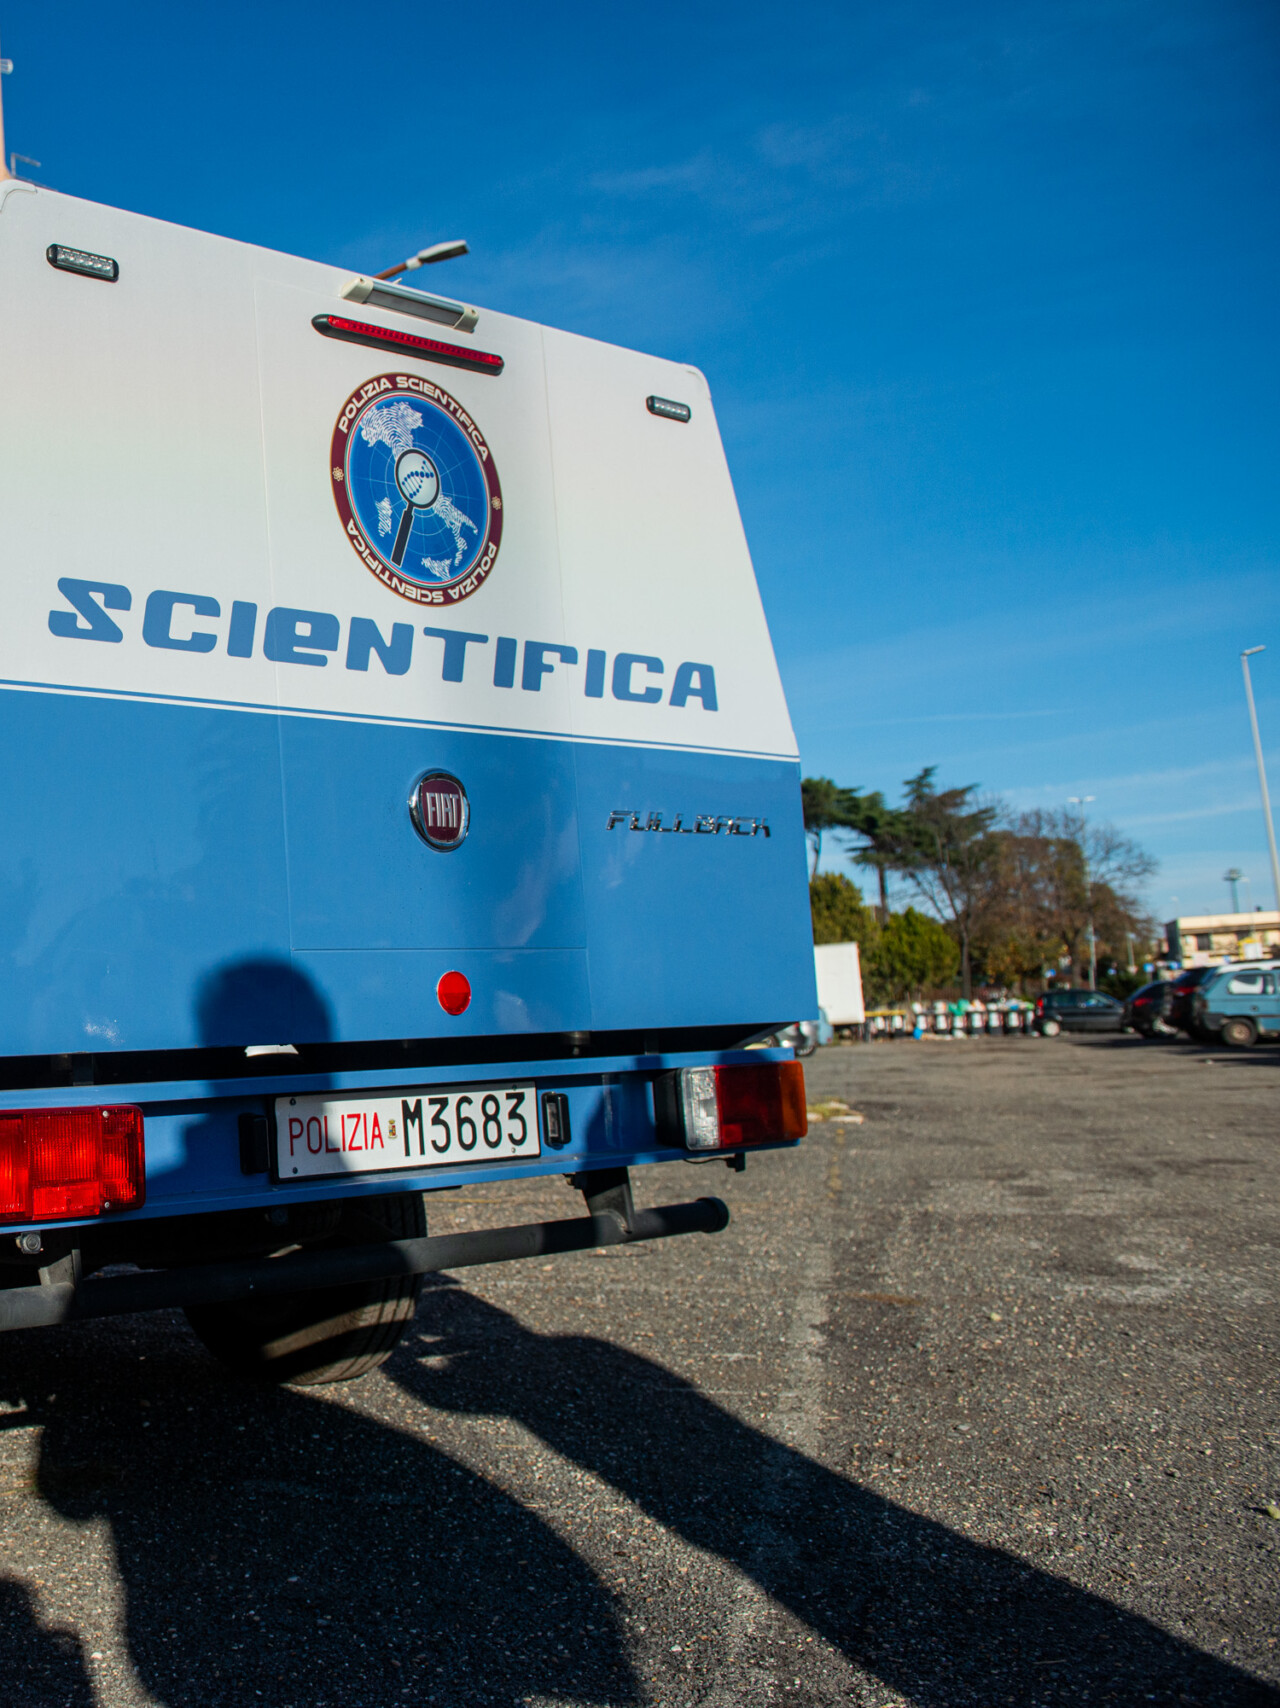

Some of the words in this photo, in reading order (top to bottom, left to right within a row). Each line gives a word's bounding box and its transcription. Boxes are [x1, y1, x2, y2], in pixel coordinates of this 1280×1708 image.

[338, 376, 393, 434] POLIZIA
[395, 376, 489, 462] SCIENTIFICA
[347, 518, 444, 603] SCIENTIFICA
[447, 542, 497, 600] POLIZIA
[426, 791, 461, 829] FIAT
[606, 810, 770, 838] FULLBACK
[288, 1111, 385, 1157] POLIZIA
[400, 1091, 529, 1157] M3683
